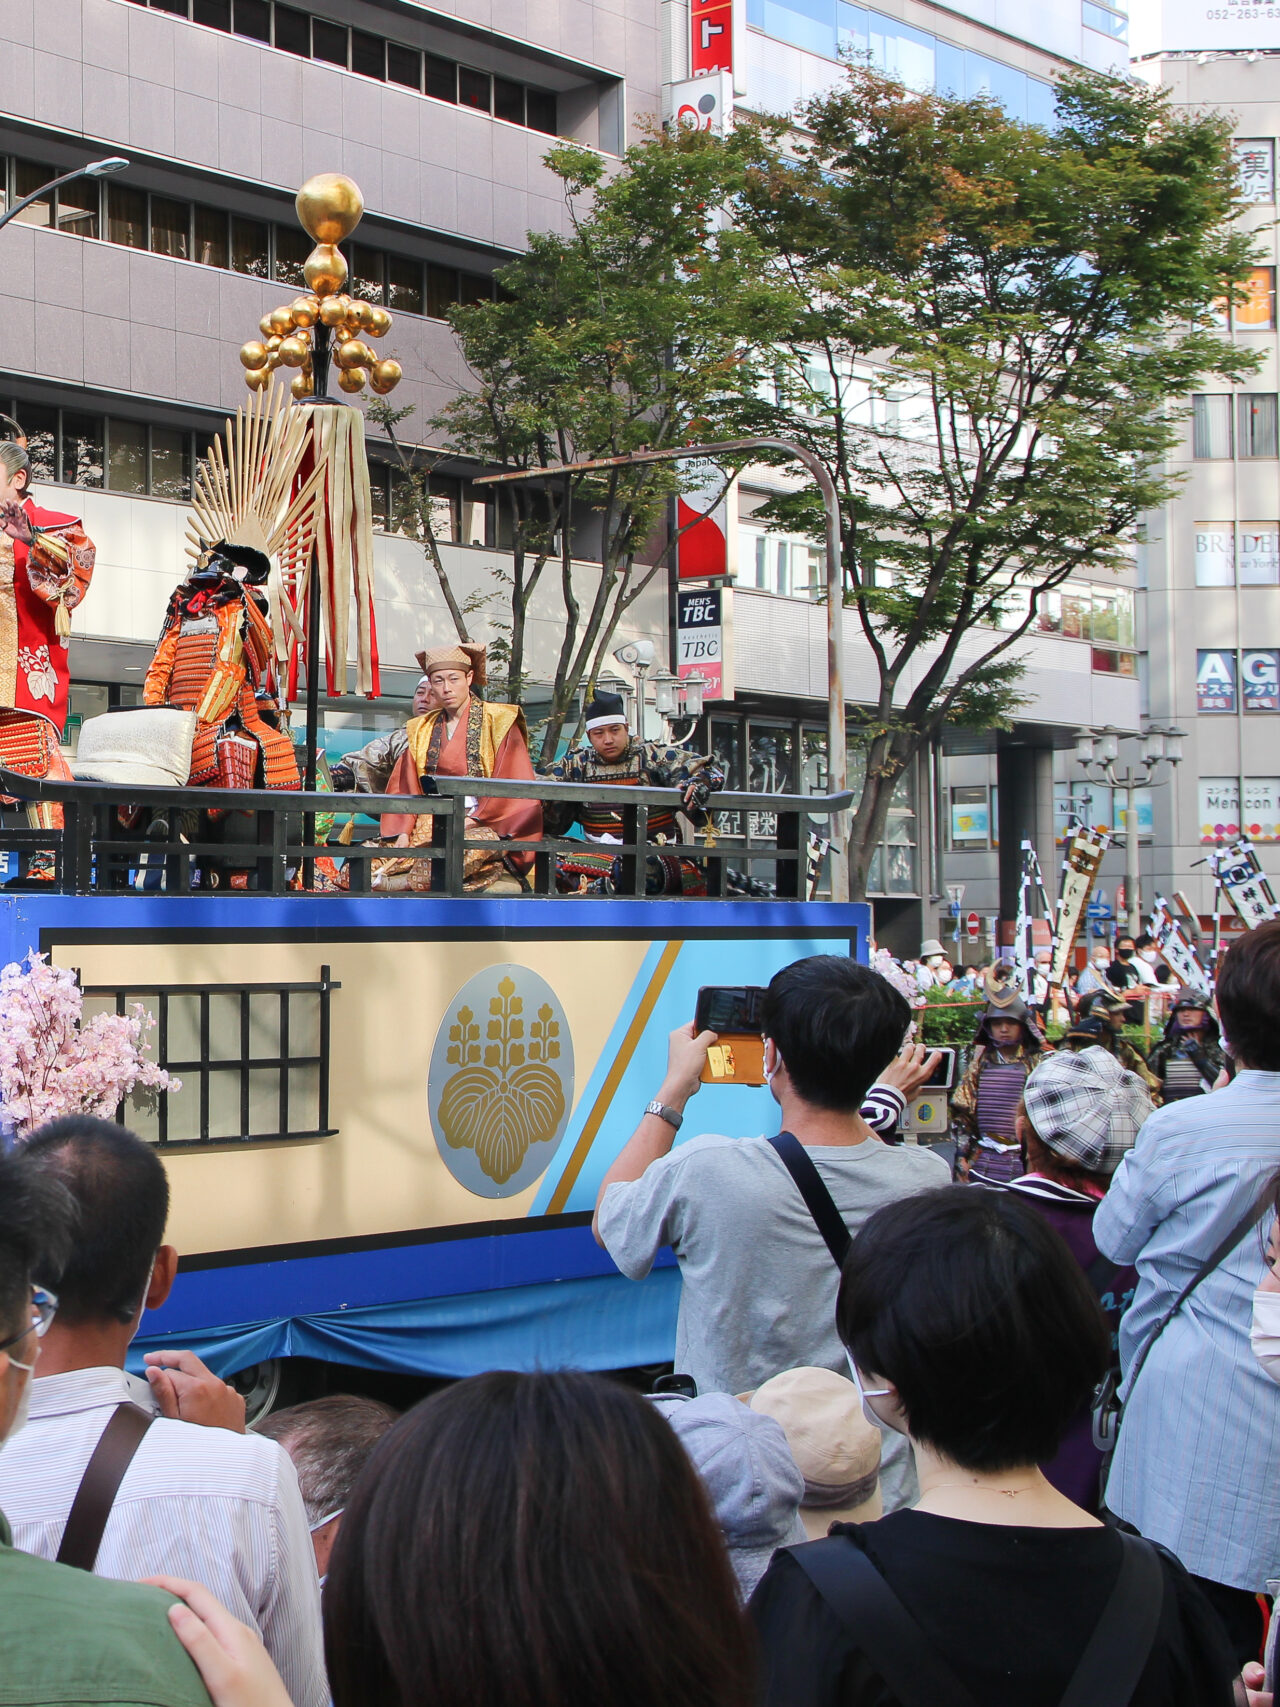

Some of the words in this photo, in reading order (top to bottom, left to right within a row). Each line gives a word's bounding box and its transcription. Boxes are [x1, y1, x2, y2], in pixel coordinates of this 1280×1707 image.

[688, 597, 711, 607] MEN'S
[683, 605, 716, 623] TBC
[682, 640, 719, 658] TBC
[1207, 797, 1272, 809] Mencon
